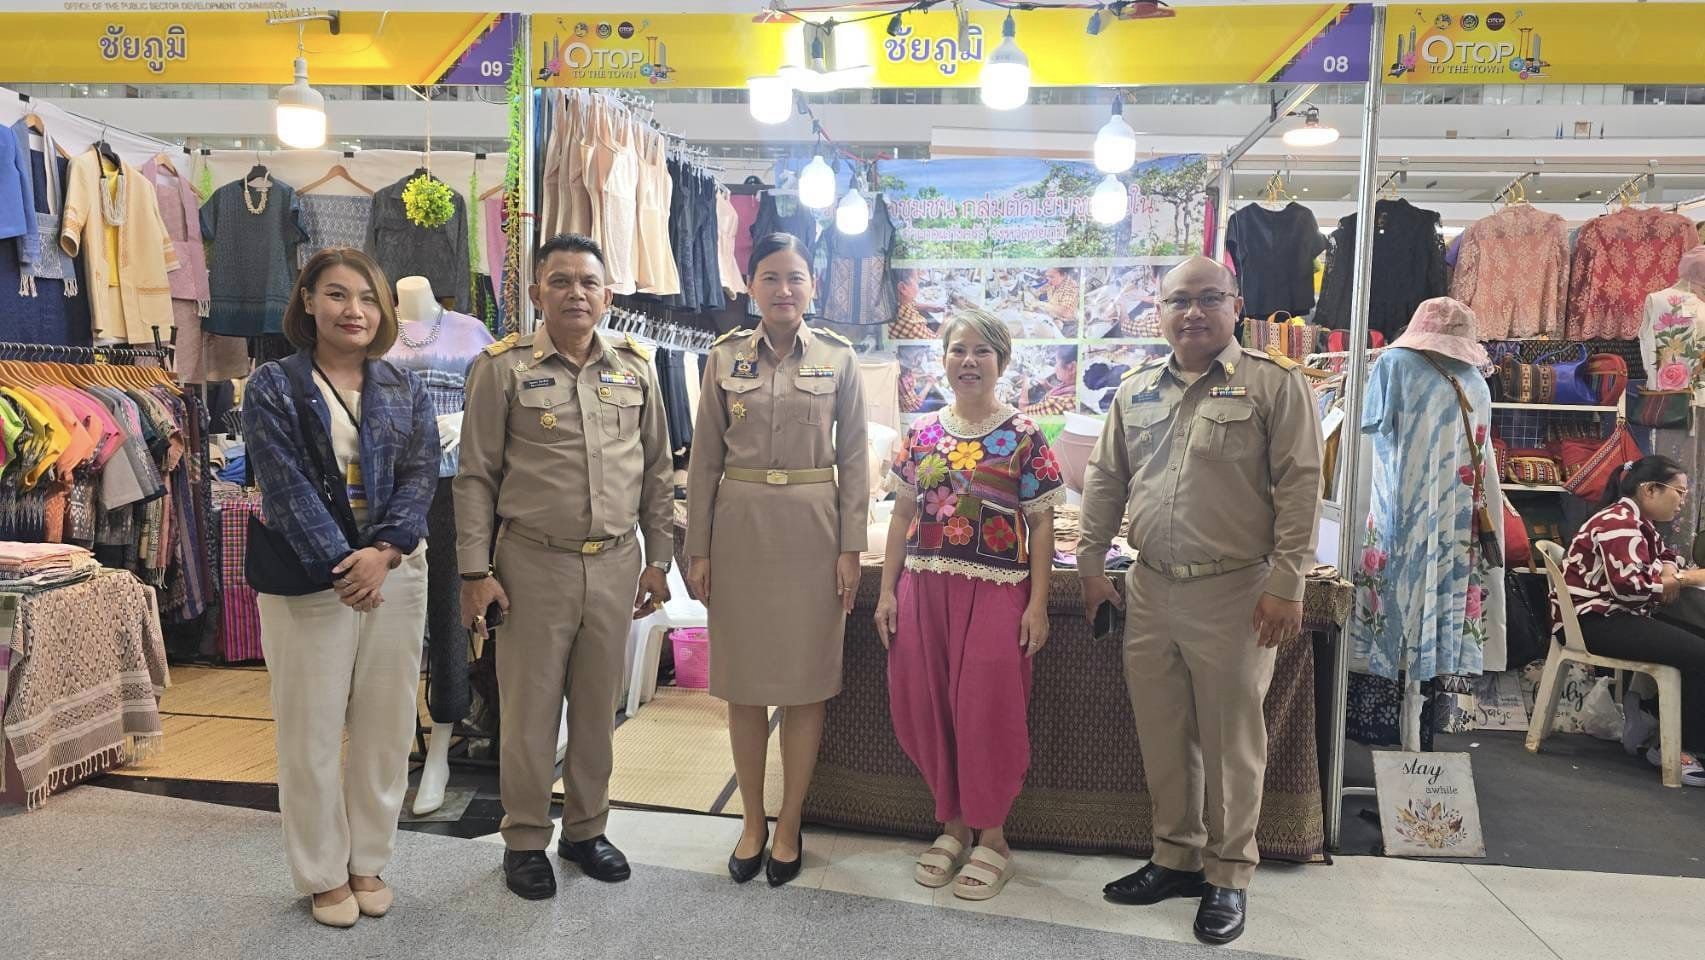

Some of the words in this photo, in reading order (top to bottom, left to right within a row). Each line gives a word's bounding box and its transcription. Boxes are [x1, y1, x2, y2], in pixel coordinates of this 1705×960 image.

[64, 2, 91, 10] OFFICE
[93, 2, 103, 10] OF
[105, 2, 119, 10] THE
[122, 2, 148, 10] PUBLIC
[150, 2, 180, 10] SECTOR
[182, 2, 236, 10] DEVELOPMENT
[239, 2, 287, 10] COMMISSION
[99, 24, 186, 72] ชัยภูมิ
[563, 42, 644, 69] OTOP
[884, 25, 983, 75] ชัยภูมิ
[1421, 35, 1515, 64] OTOP
[480, 60, 503, 77] 09
[1323, 56, 1349, 73] 08
[1429, 64, 1444, 74] TO
[1448, 64, 1468, 74] THE
[1471, 64, 1504, 74] TOWN
[572, 70, 585, 79] TO
[590, 70, 608, 79] THE
[610, 70, 637, 79] TOWN
[1402, 758, 1444, 785] stay
[1425, 786, 1458, 795] awhile
